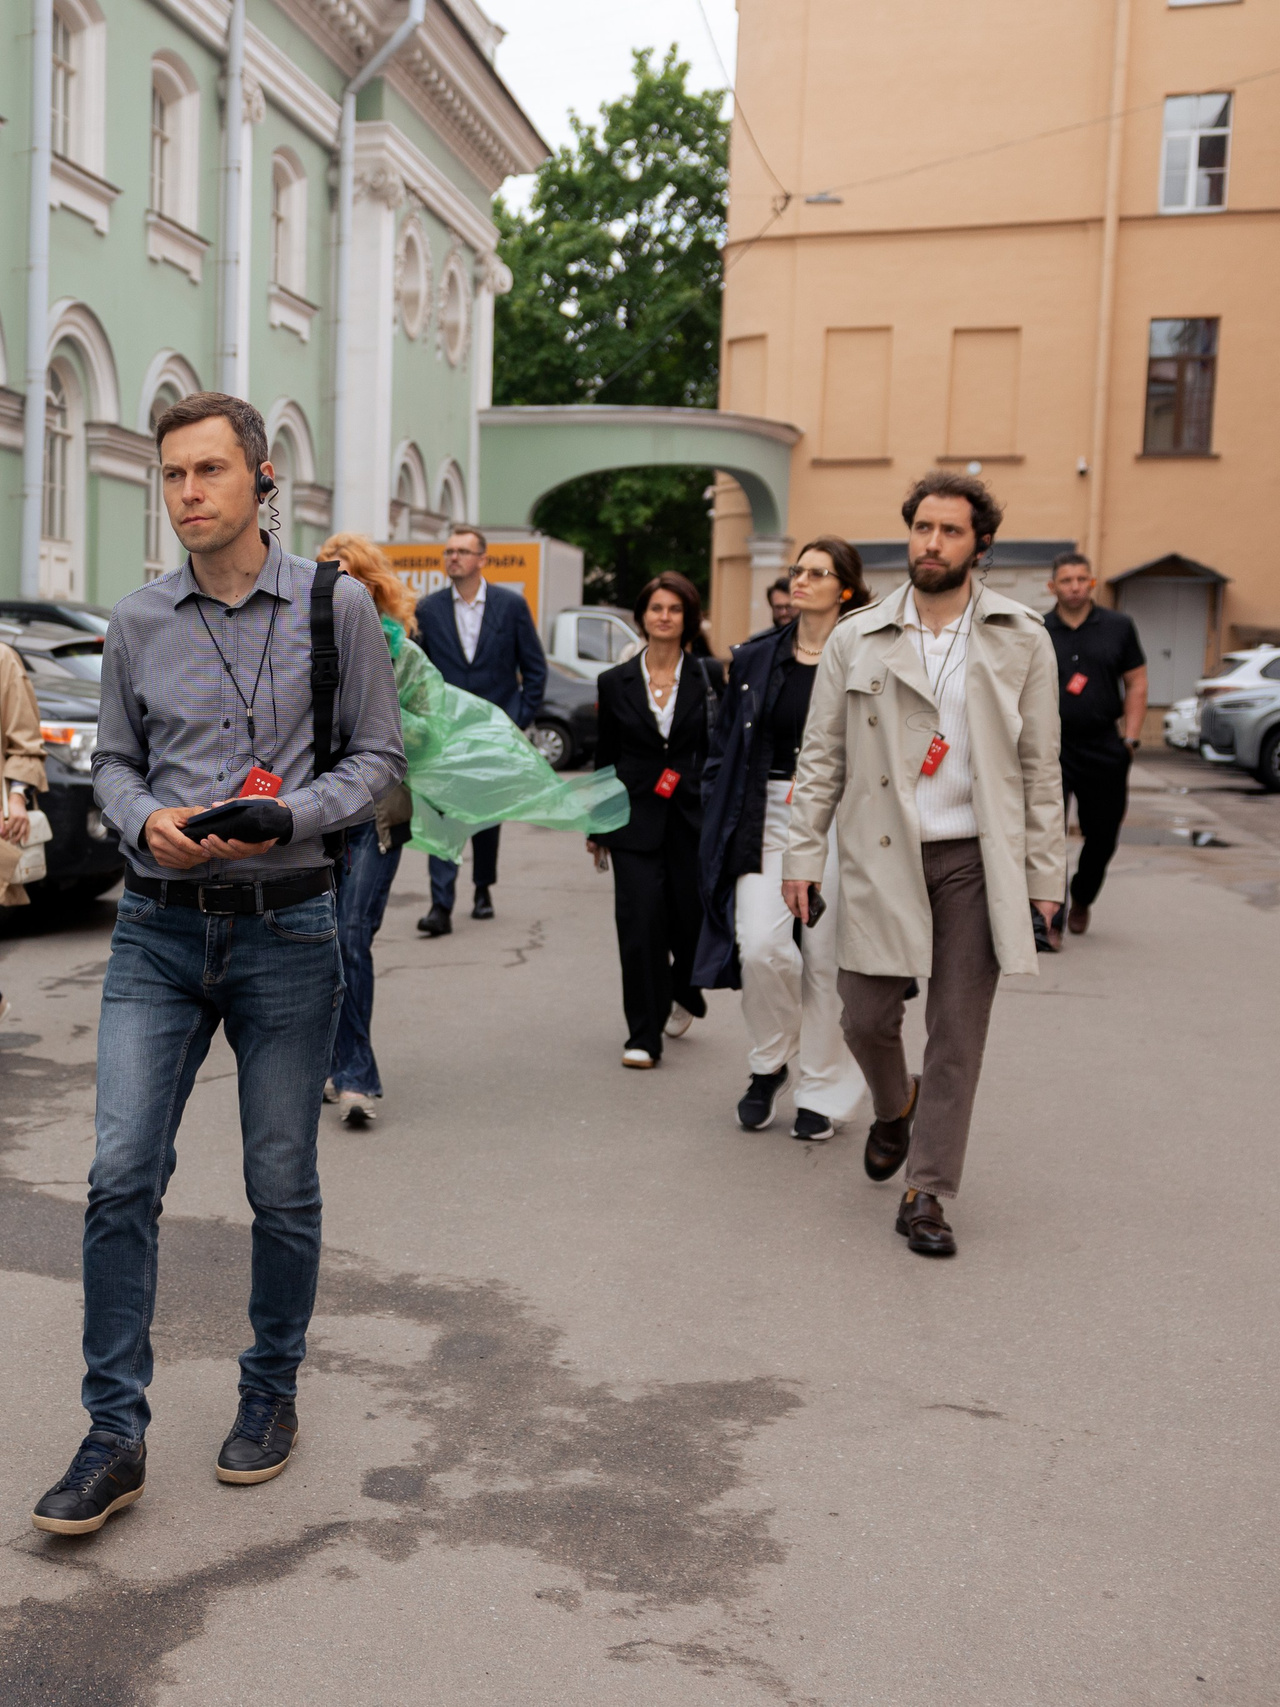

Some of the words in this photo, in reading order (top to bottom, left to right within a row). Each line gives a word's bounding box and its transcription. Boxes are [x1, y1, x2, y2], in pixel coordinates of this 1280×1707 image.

[393, 556, 441, 568] МЕБЕЛИ
[486, 555, 526, 567] РЬЕРА
[397, 570, 451, 600] ТУР
